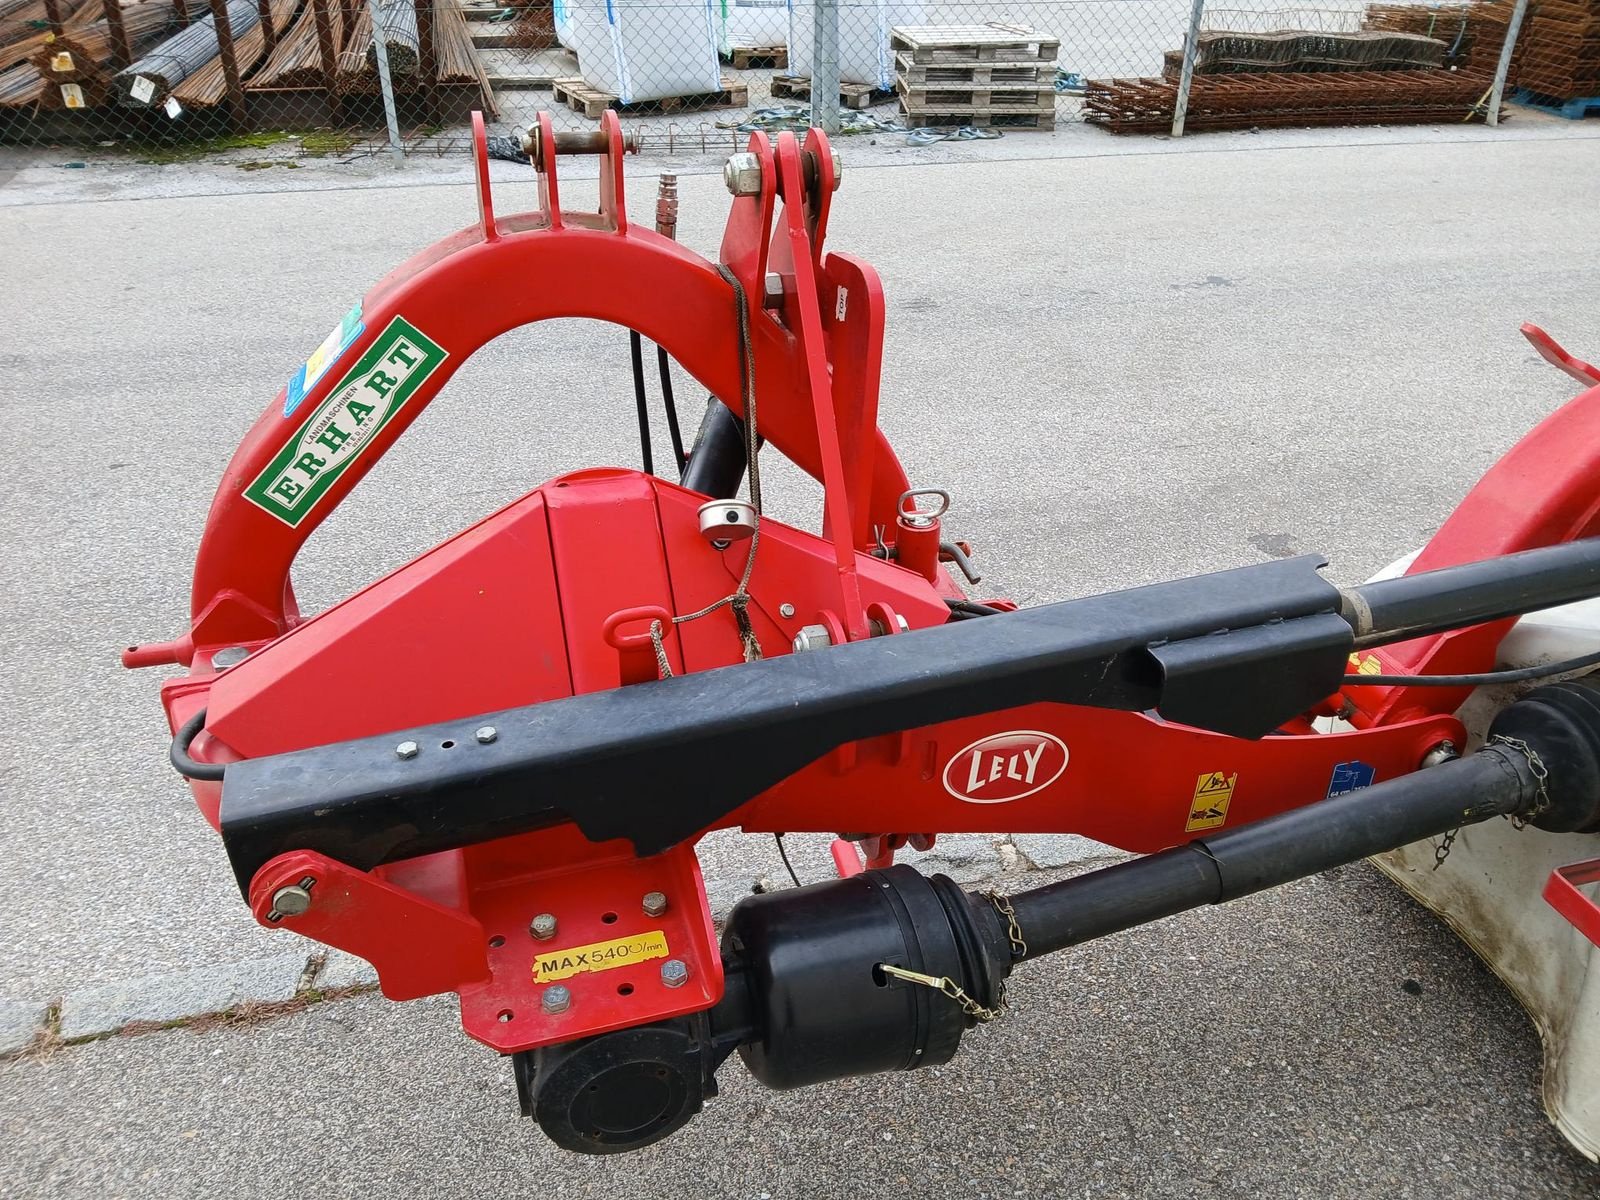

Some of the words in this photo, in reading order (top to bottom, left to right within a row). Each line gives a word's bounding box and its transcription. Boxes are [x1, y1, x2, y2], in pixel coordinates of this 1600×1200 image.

[271, 341, 418, 504] ERHART
[305, 386, 358, 445] LANDMASCHINEN
[341, 417, 374, 452] PREDING
[966, 741, 1047, 794] LELY
[542, 953, 588, 974] MAX
